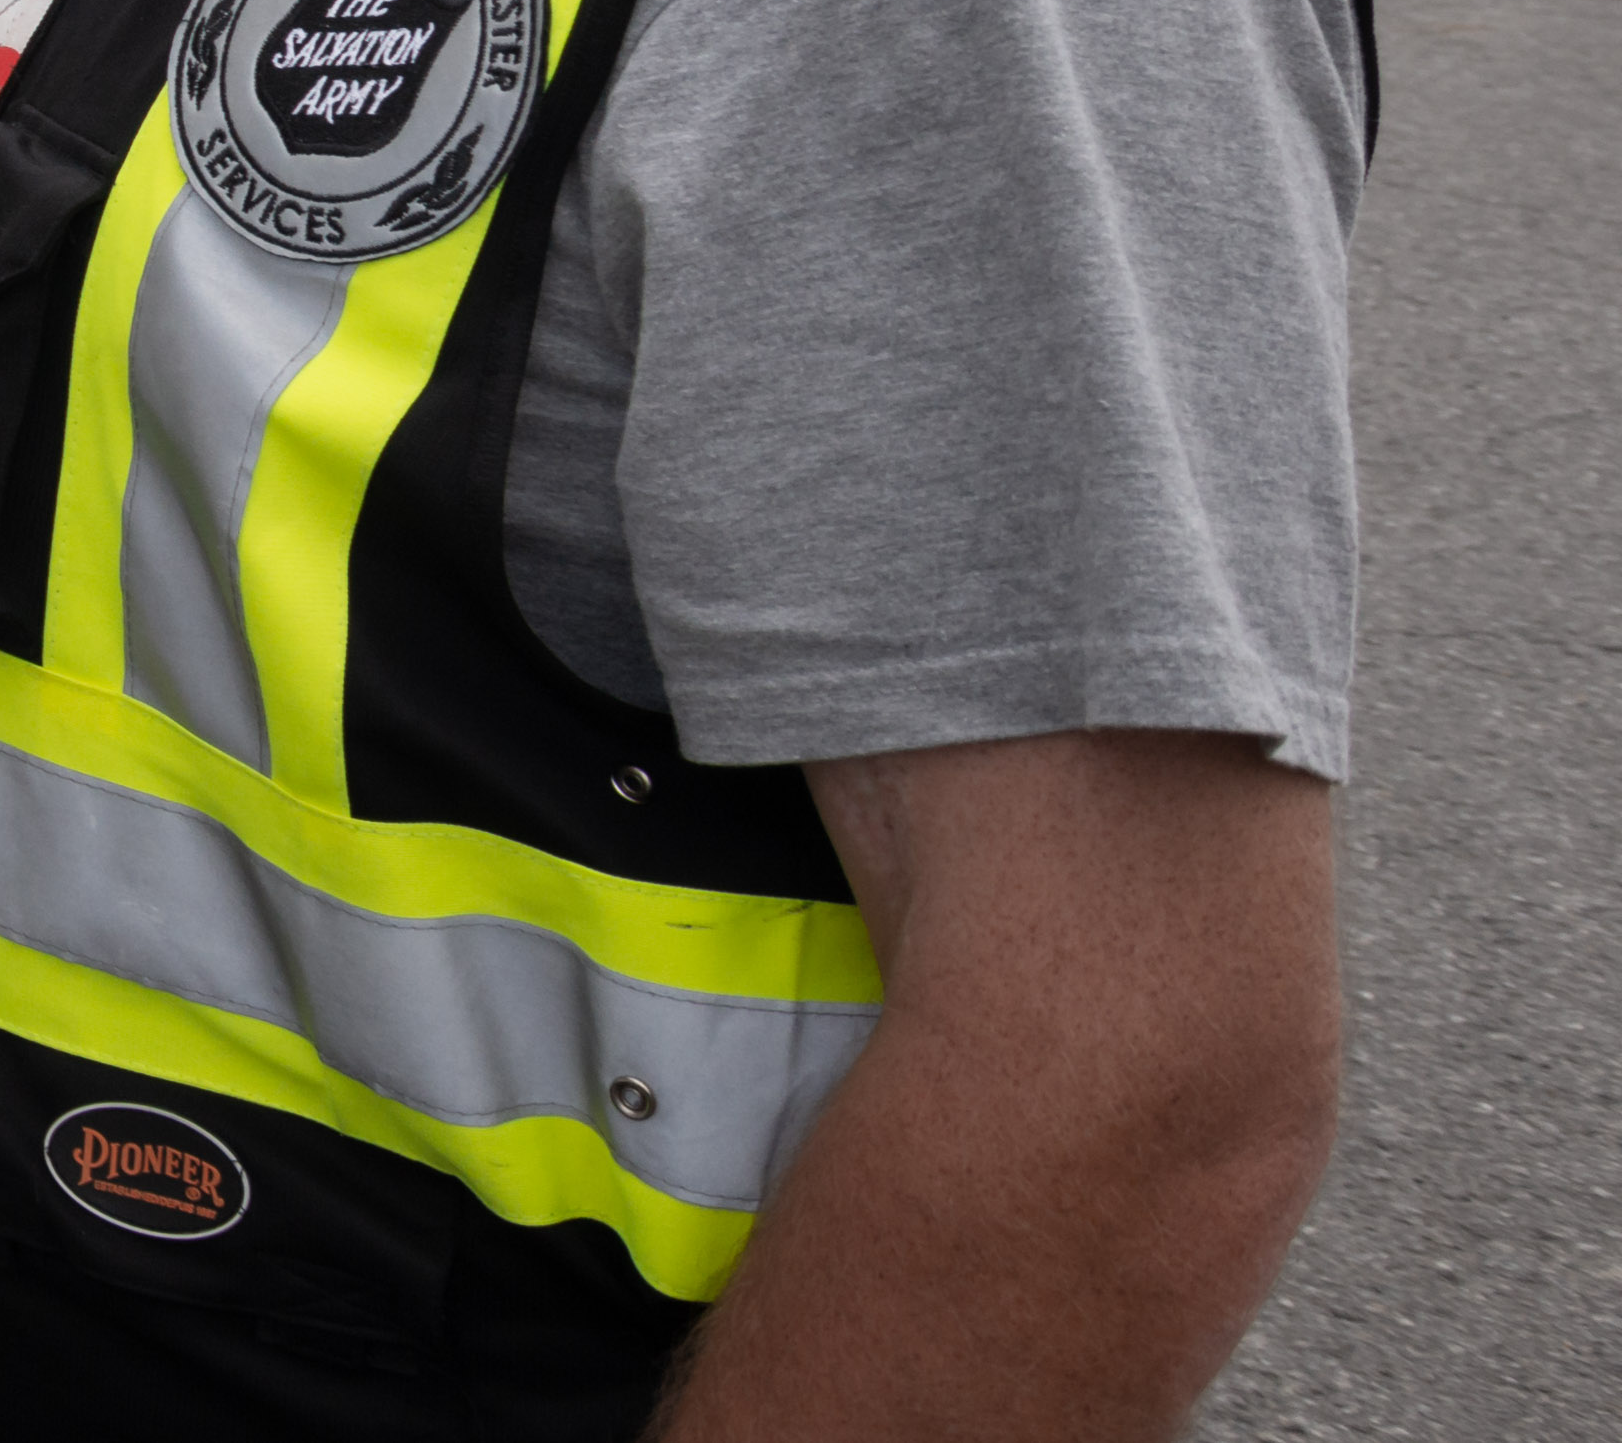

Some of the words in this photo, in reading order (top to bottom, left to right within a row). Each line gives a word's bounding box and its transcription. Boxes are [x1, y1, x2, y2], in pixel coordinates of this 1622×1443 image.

[272, 23, 436, 71] SALVATION
[294, 75, 403, 124] ARMY
[196, 129, 347, 245] SERVICES
[72, 1125, 225, 1208] PIONEER
